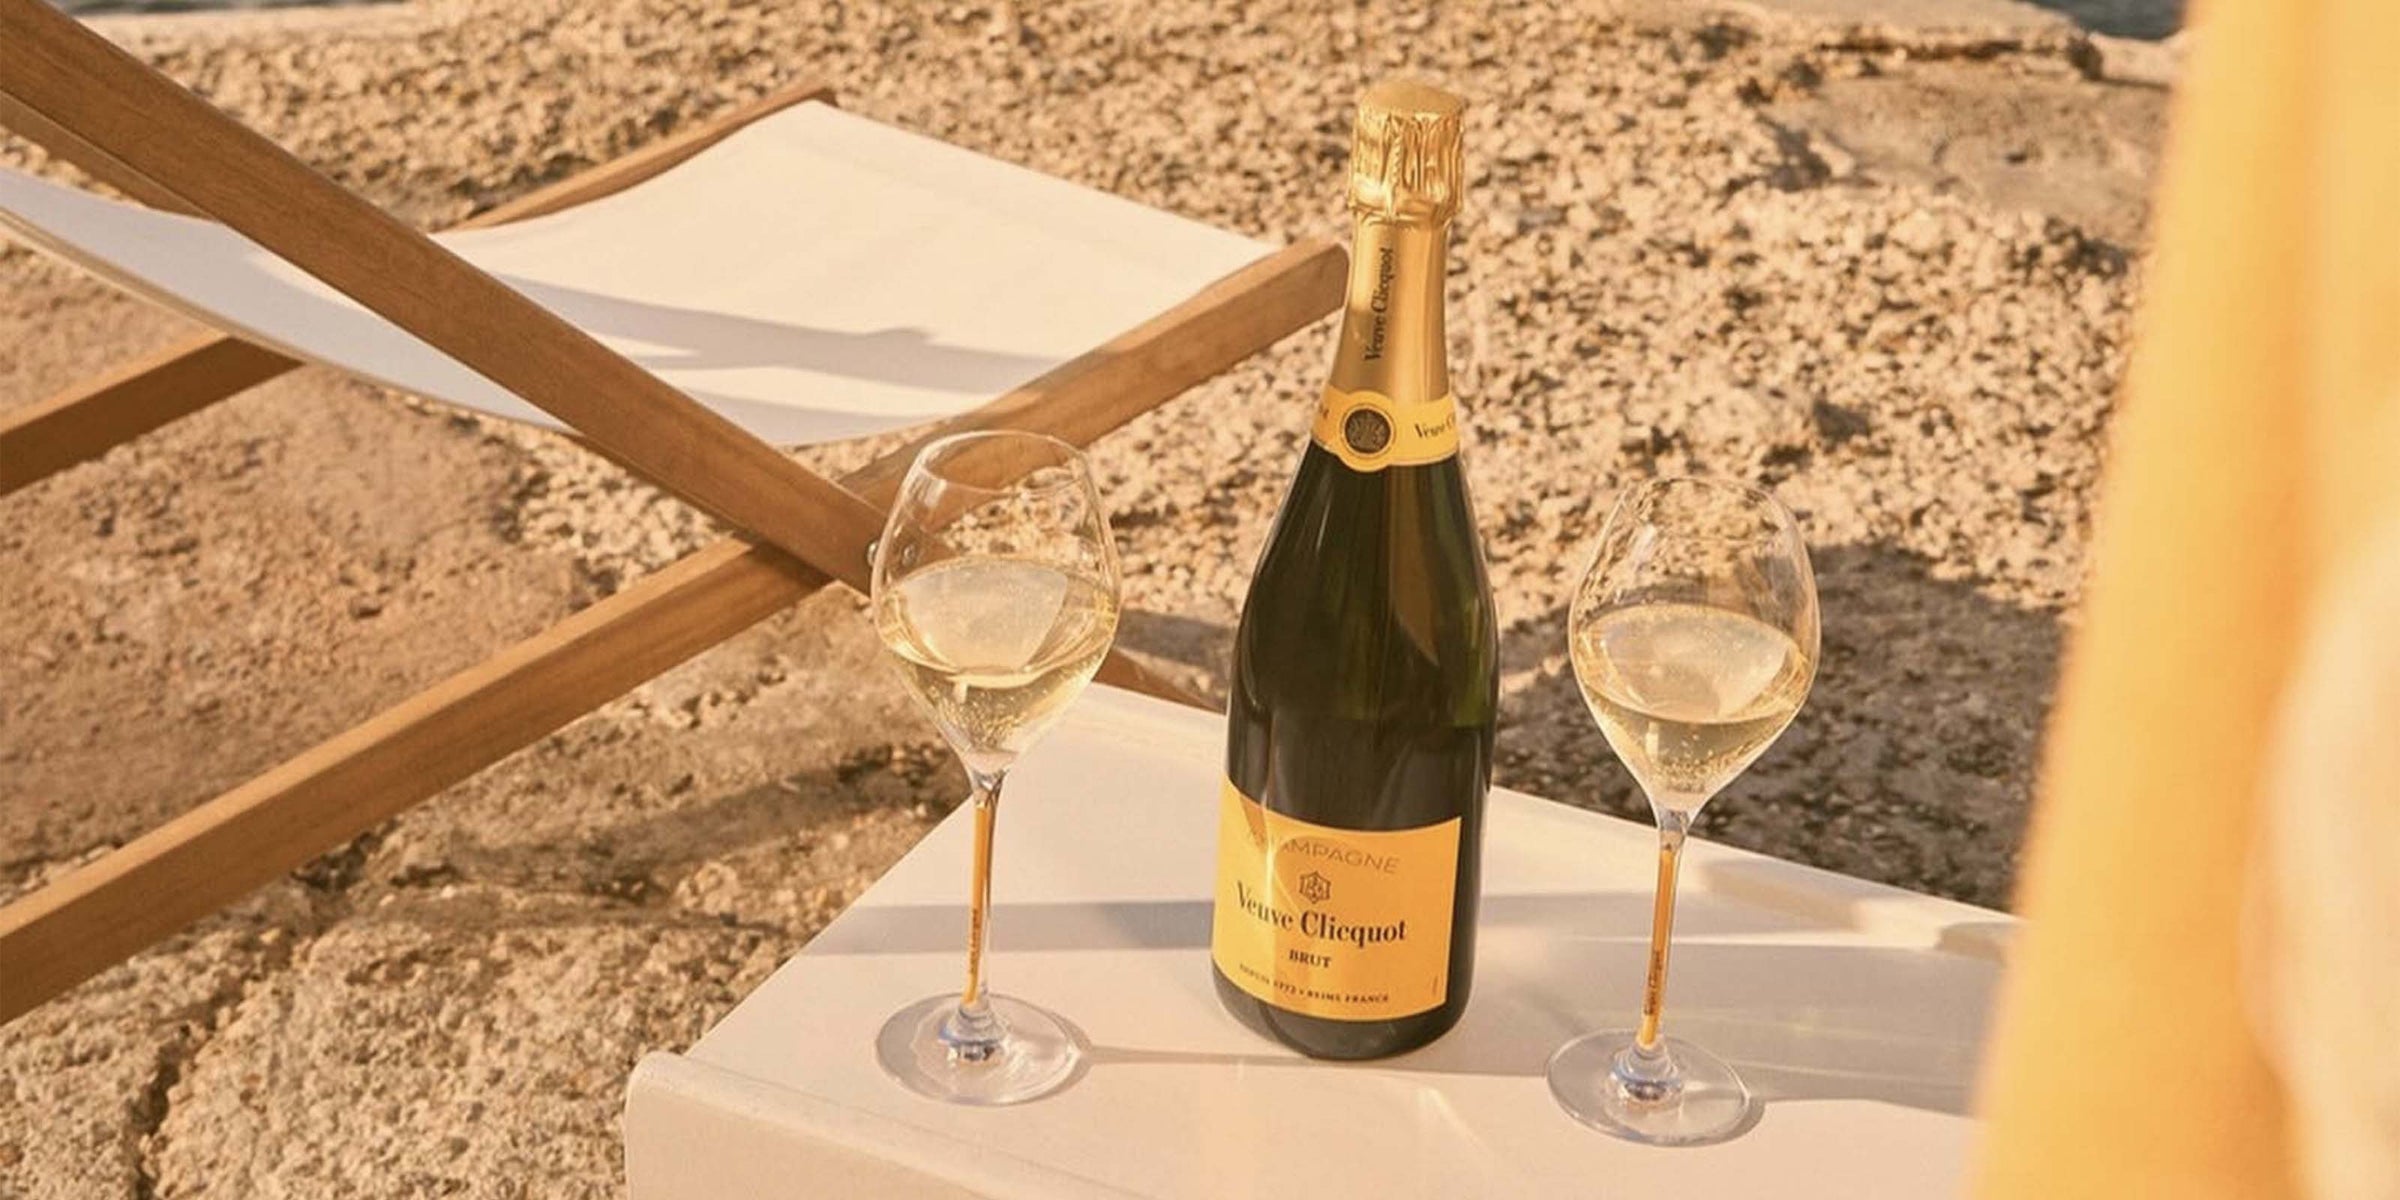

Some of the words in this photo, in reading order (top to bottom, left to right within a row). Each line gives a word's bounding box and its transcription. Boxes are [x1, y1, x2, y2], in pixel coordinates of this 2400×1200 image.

[1371, 247, 1395, 313] Clicquot
[1364, 315, 1387, 362] Veuve
[1249, 829, 1400, 874] AMPAGNE
[1236, 879, 1294, 931] Veuve
[1300, 909, 1407, 949] Clicquot
[1289, 948, 1332, 969] BRUT
[1345, 993, 1389, 1003] FRANCE
